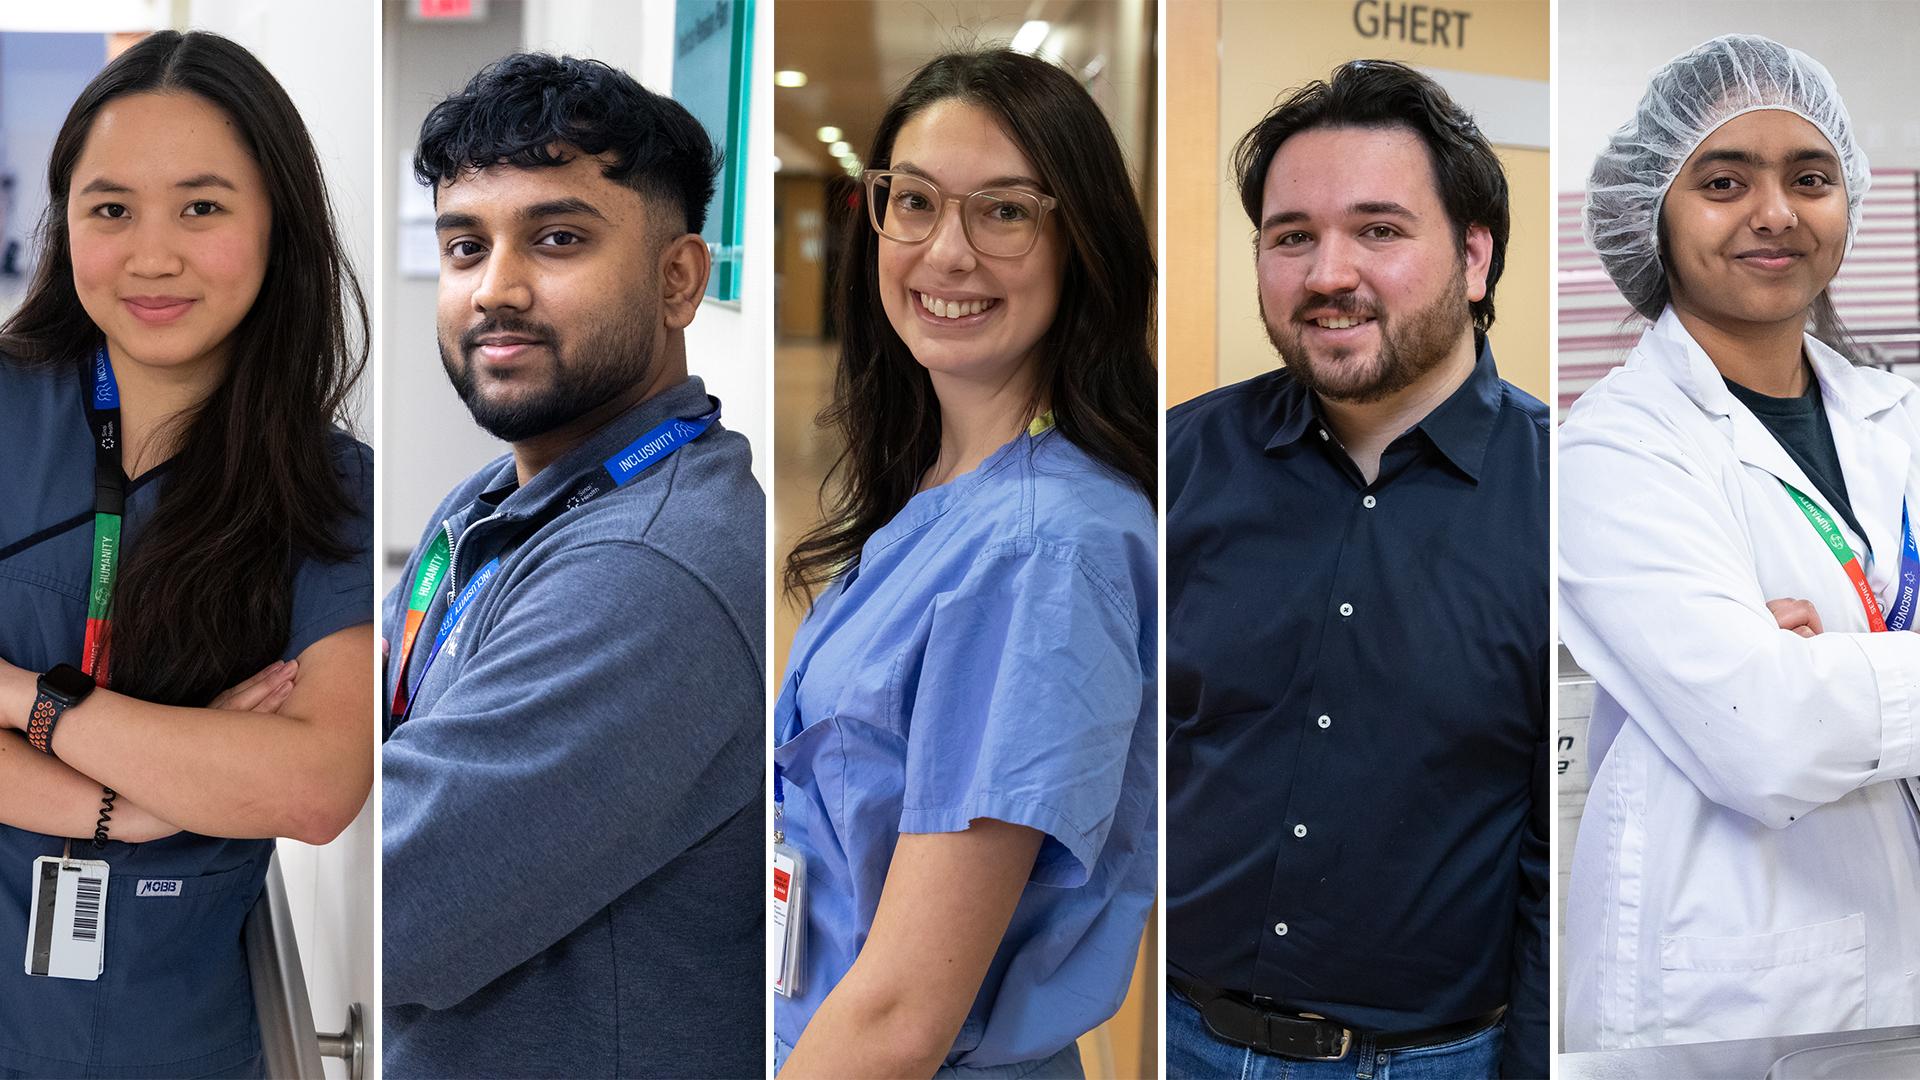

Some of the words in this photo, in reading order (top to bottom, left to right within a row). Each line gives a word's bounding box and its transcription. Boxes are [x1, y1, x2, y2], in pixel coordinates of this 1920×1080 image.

[1353, 0, 1472, 49] GHERT
[618, 431, 675, 472] INCLUSIVITY
[580, 487, 600, 502] Health
[1799, 495, 1833, 533] HUMANITY
[100, 536, 113, 584] HUMANITY
[418, 553, 445, 597] HUMANITY
[455, 569, 491, 615] INCLUSIVITY
[1859, 579, 1877, 615] SERVICE
[141, 881, 177, 895] MOBB
